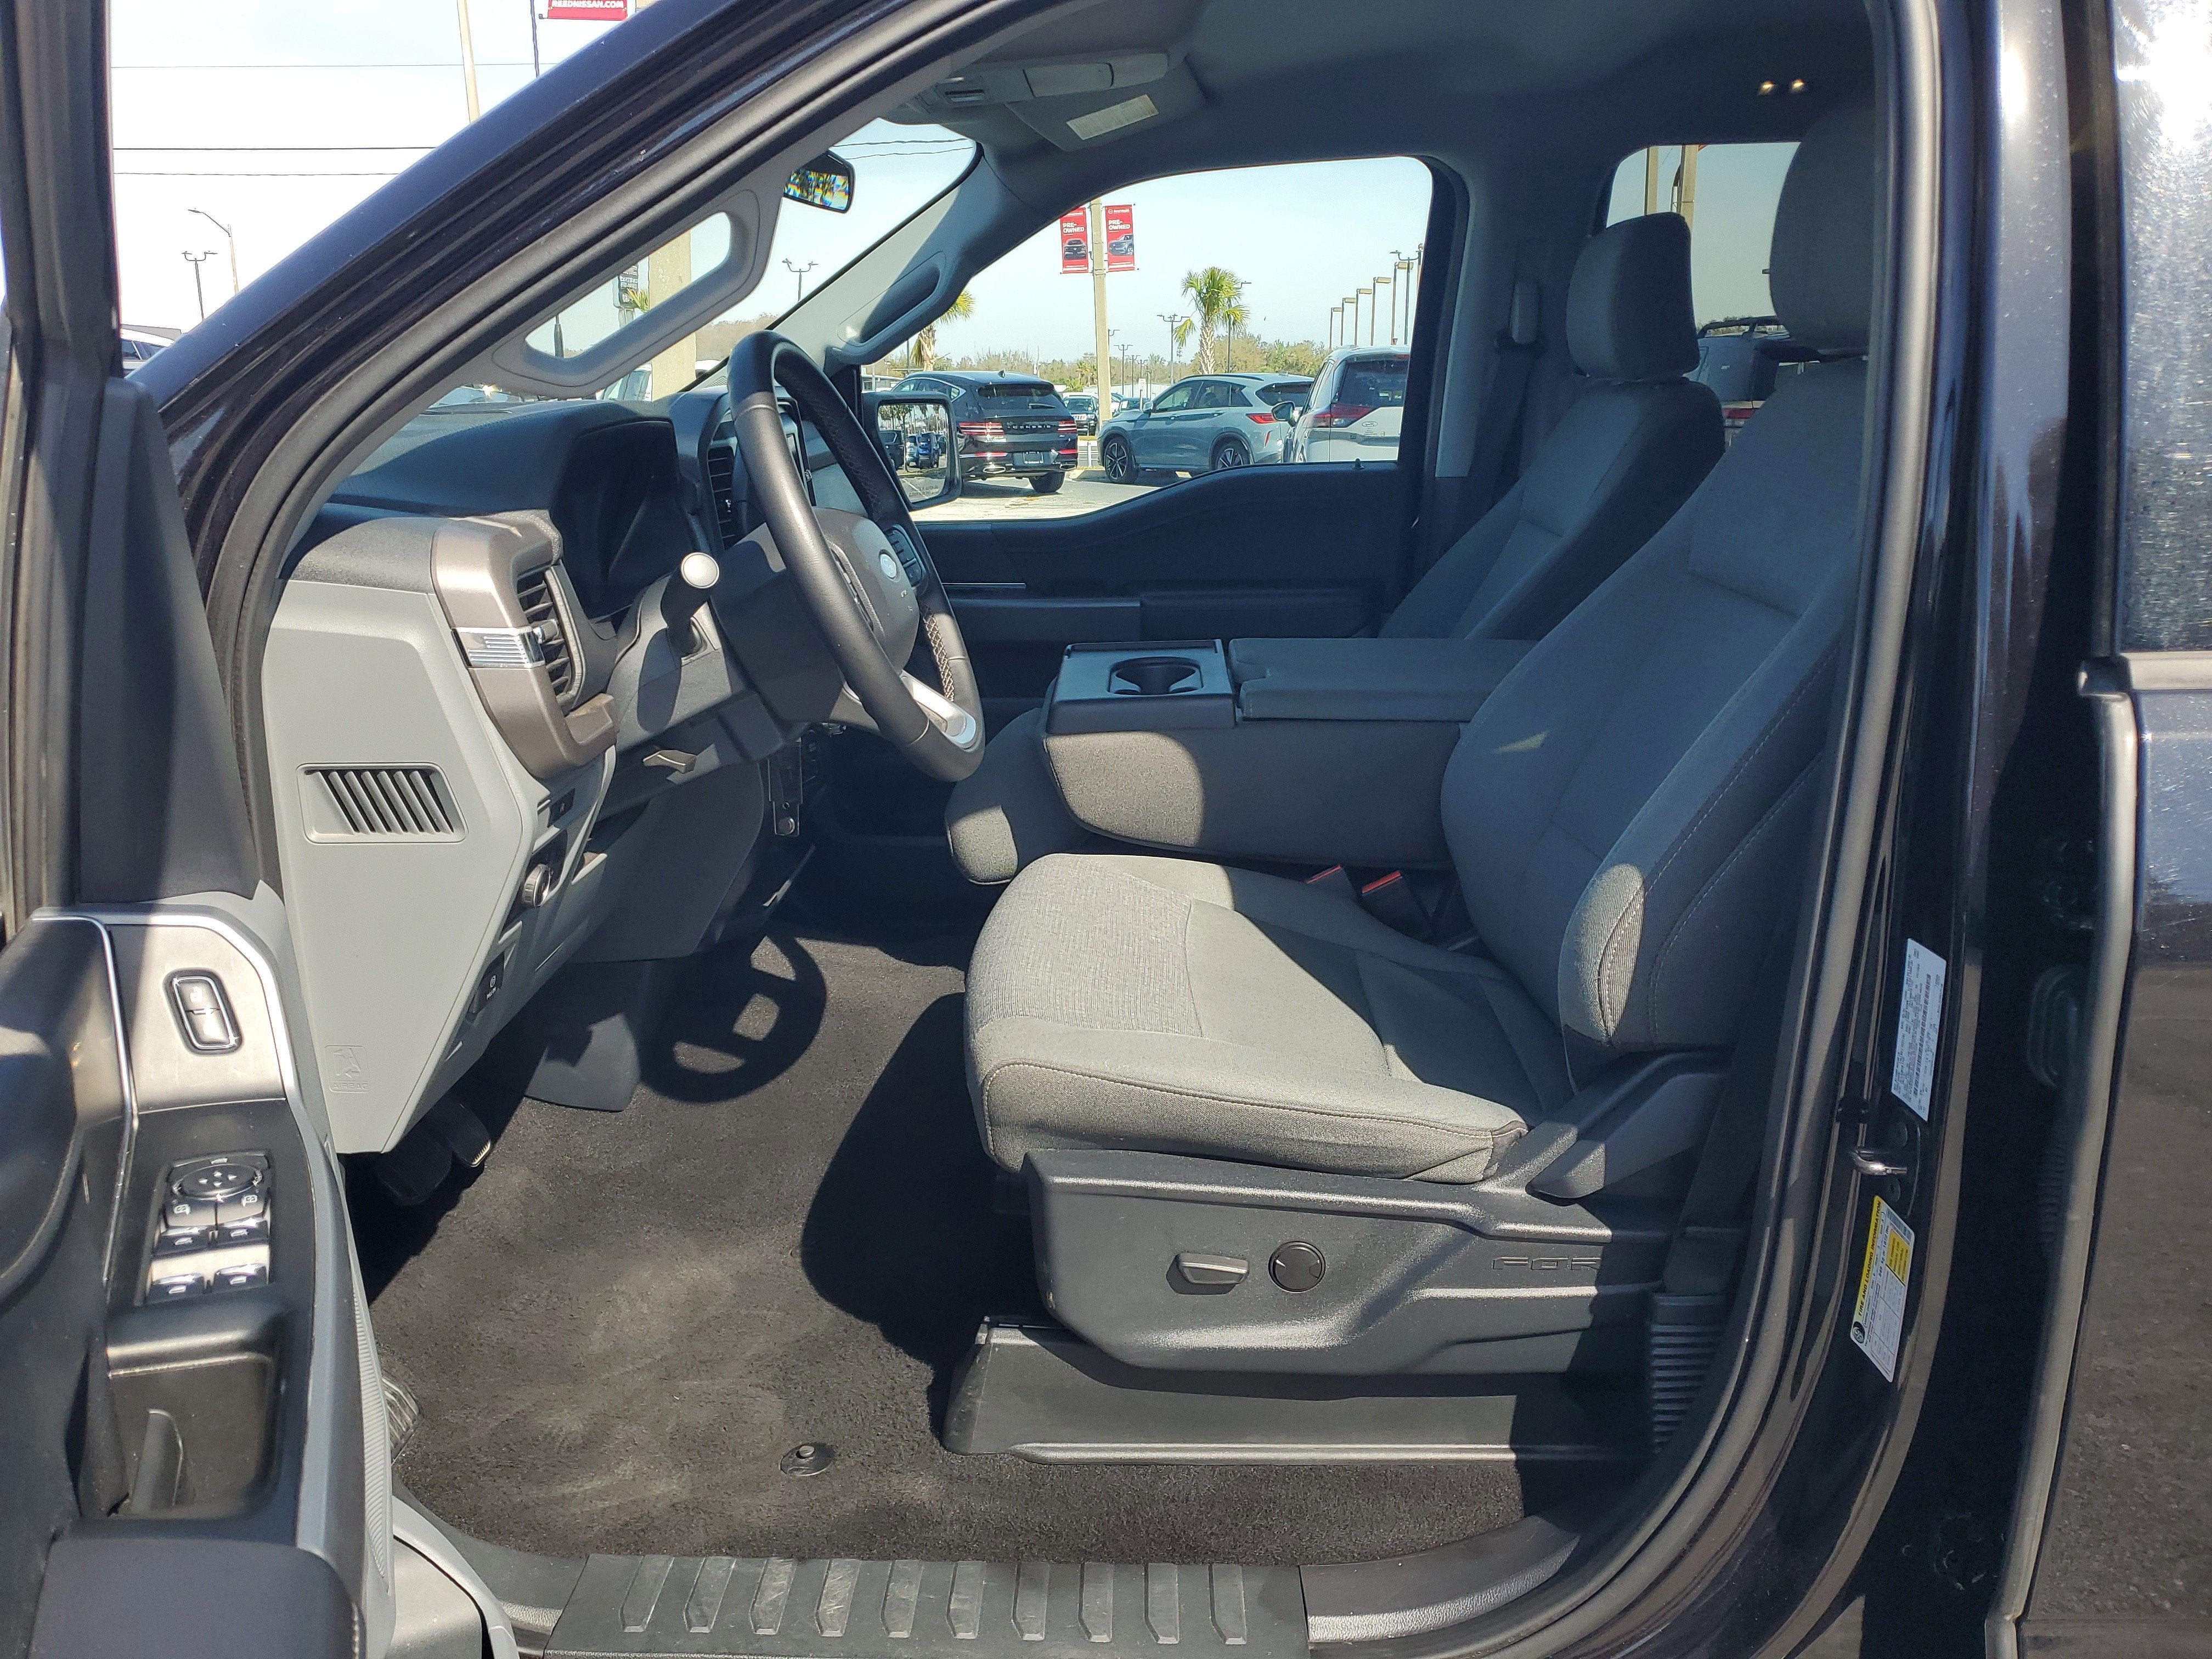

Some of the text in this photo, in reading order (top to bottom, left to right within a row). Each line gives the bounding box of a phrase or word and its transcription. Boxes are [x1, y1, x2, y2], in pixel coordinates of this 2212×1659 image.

[1492, 1256, 1602, 1271] FOR
[1865, 1251, 1874, 1283] LOADING
[1870, 1200, 1881, 1251] INFORMATION
